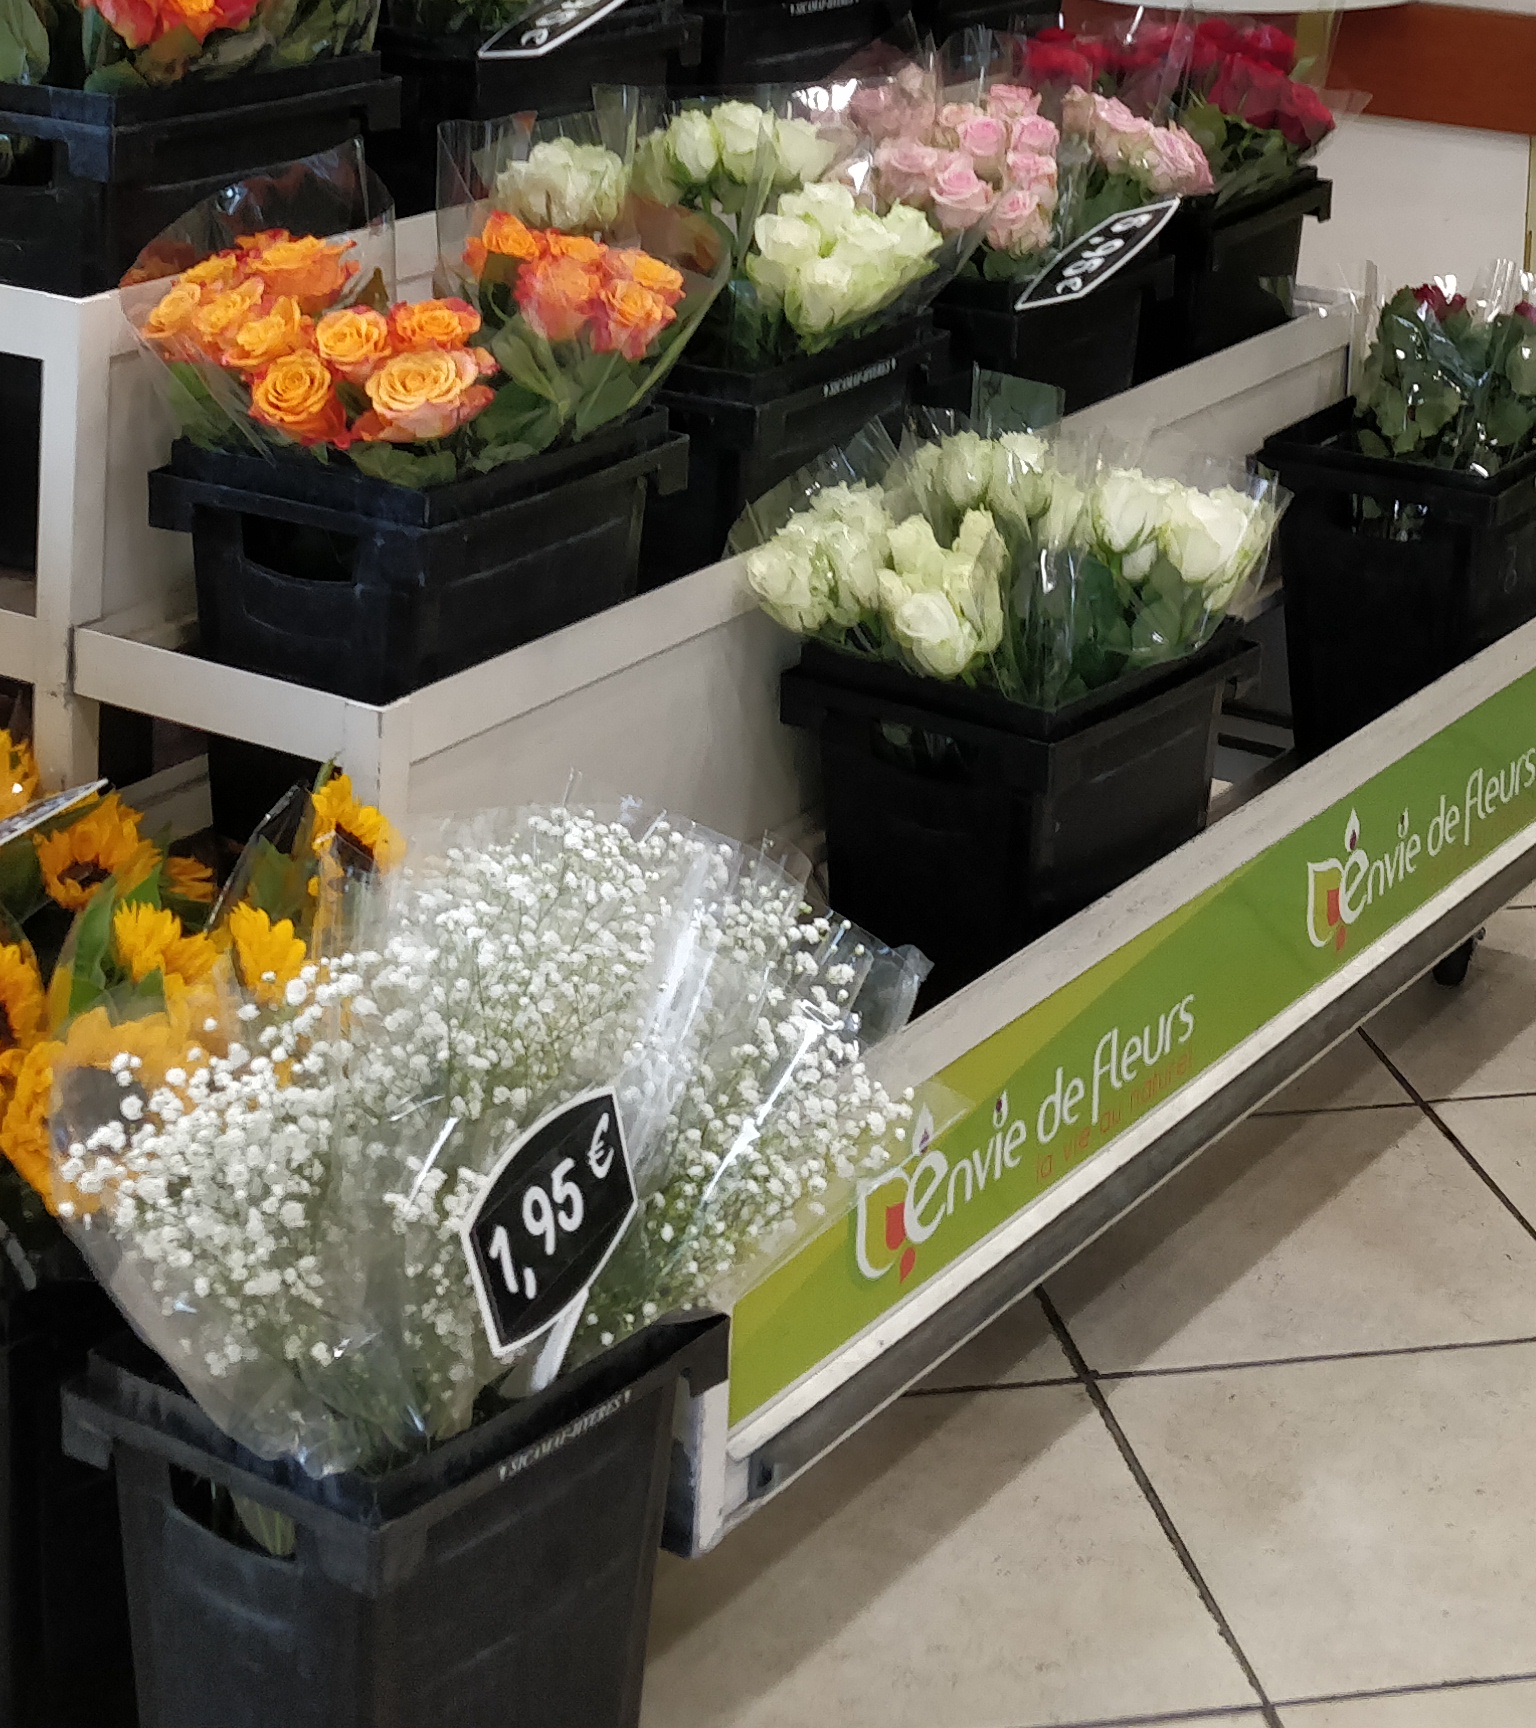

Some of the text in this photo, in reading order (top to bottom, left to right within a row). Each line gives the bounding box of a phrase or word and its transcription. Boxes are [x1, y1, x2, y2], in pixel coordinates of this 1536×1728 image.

[1427, 795, 1460, 857] de
[1464, 747, 1536, 846] fleurs
[1036, 1067, 1086, 1144] de
[1091, 993, 1196, 1125] fleurs
[1064, 1127, 1092, 1162] vie
[1099, 1109, 1122, 1134] au
[1130, 1046, 1193, 1113] naturel
